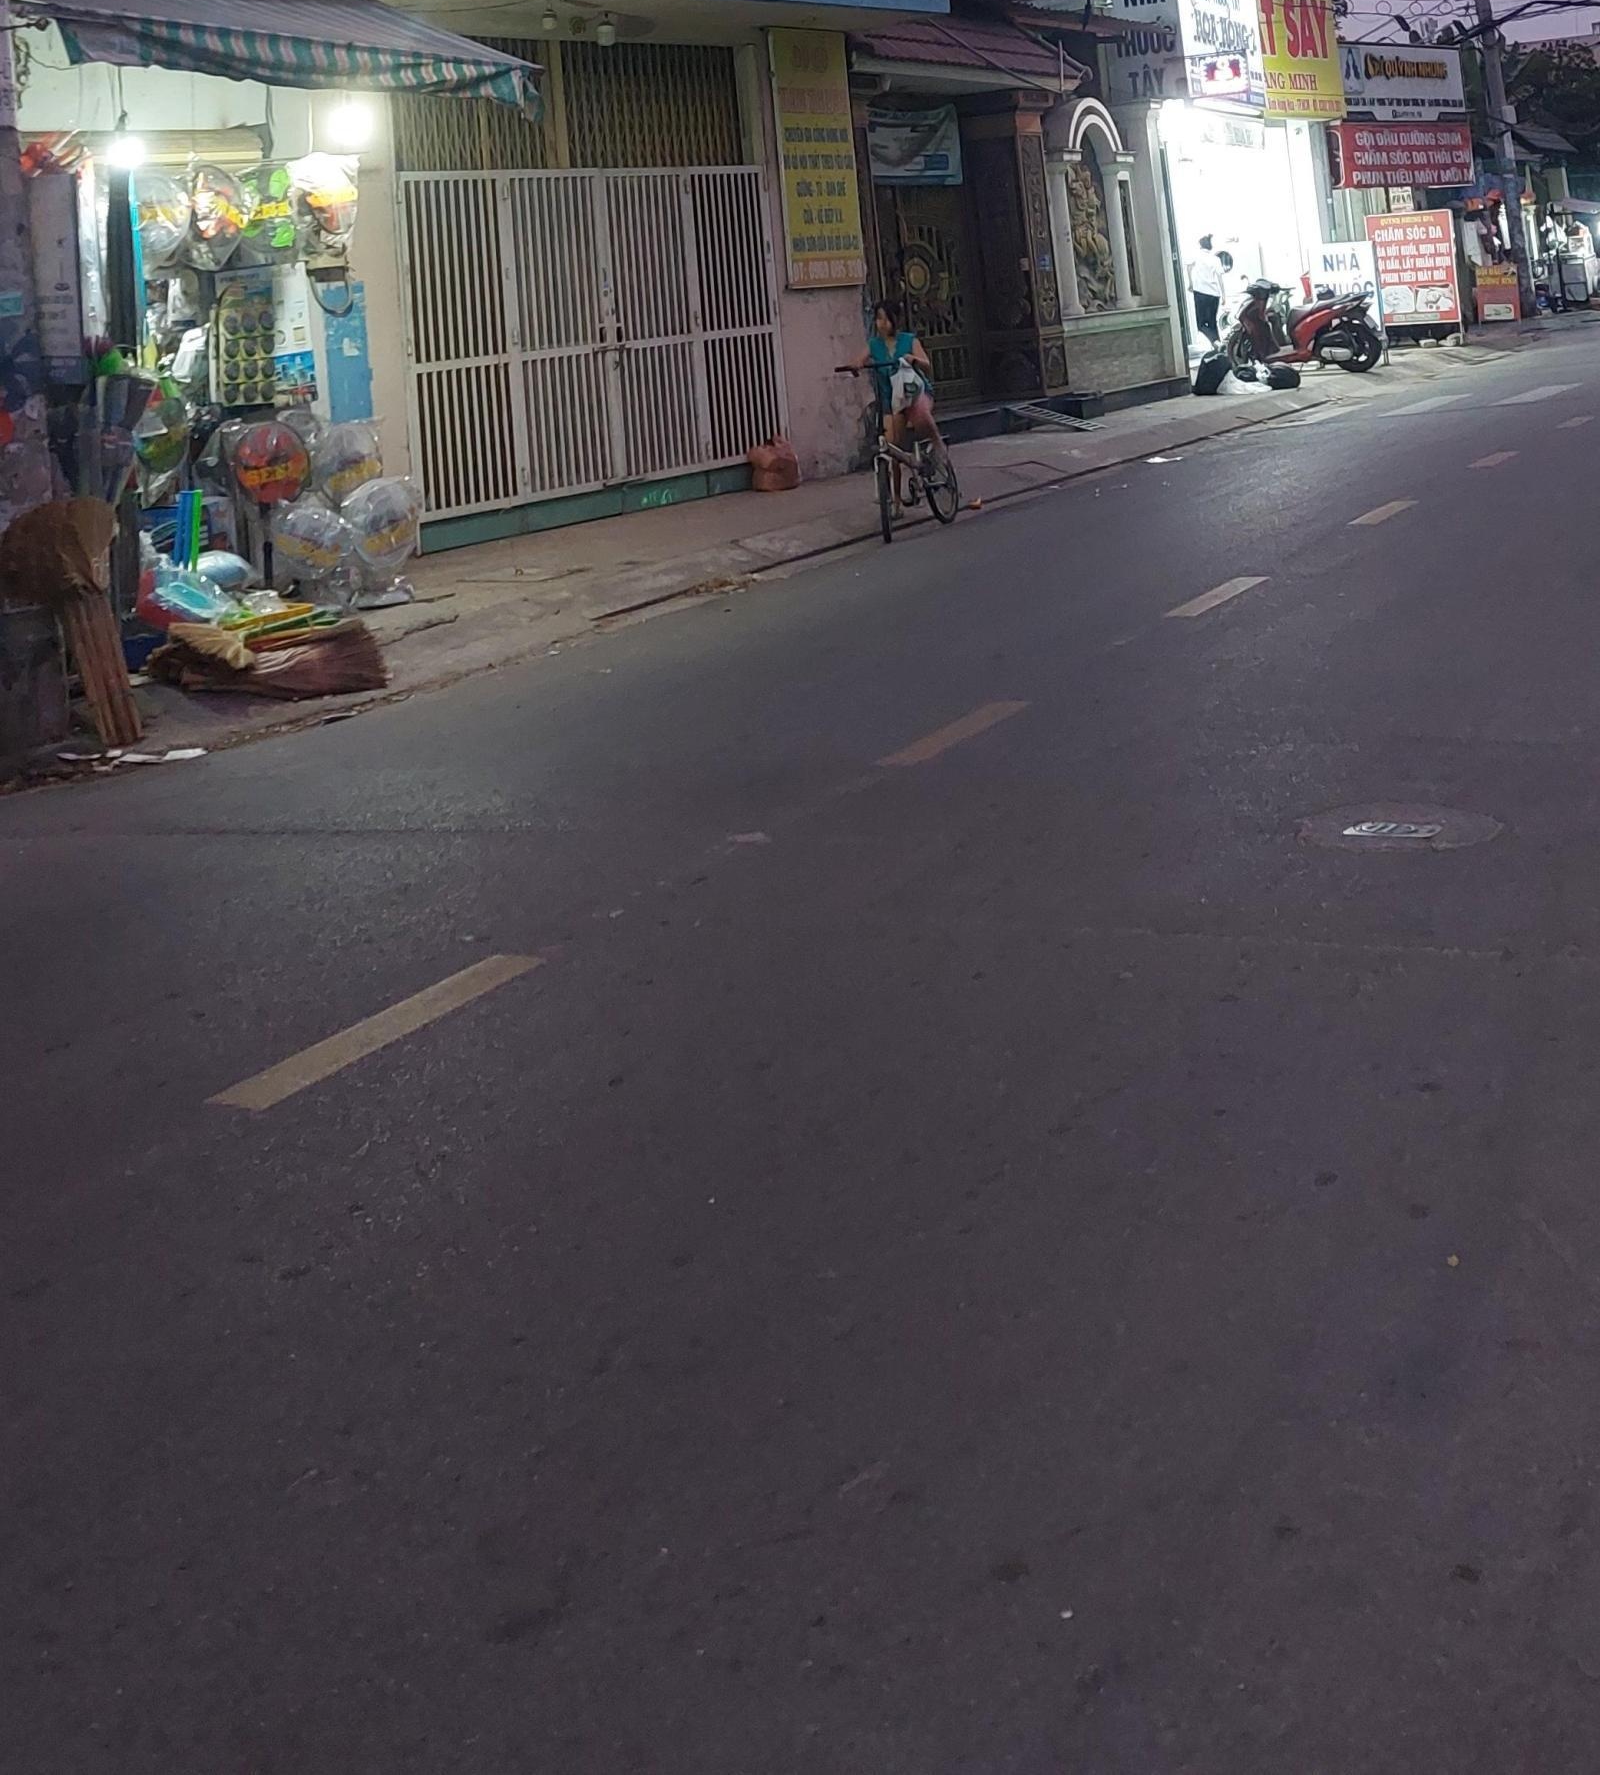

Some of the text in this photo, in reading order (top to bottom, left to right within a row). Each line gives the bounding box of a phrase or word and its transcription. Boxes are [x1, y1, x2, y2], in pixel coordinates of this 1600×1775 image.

[1127, 63, 1166, 98] TÂY
[1288, 73, 1318, 91] MINH
[1406, 225, 1427, 240] SÓC
[1322, 247, 1361, 273] NHÀ
